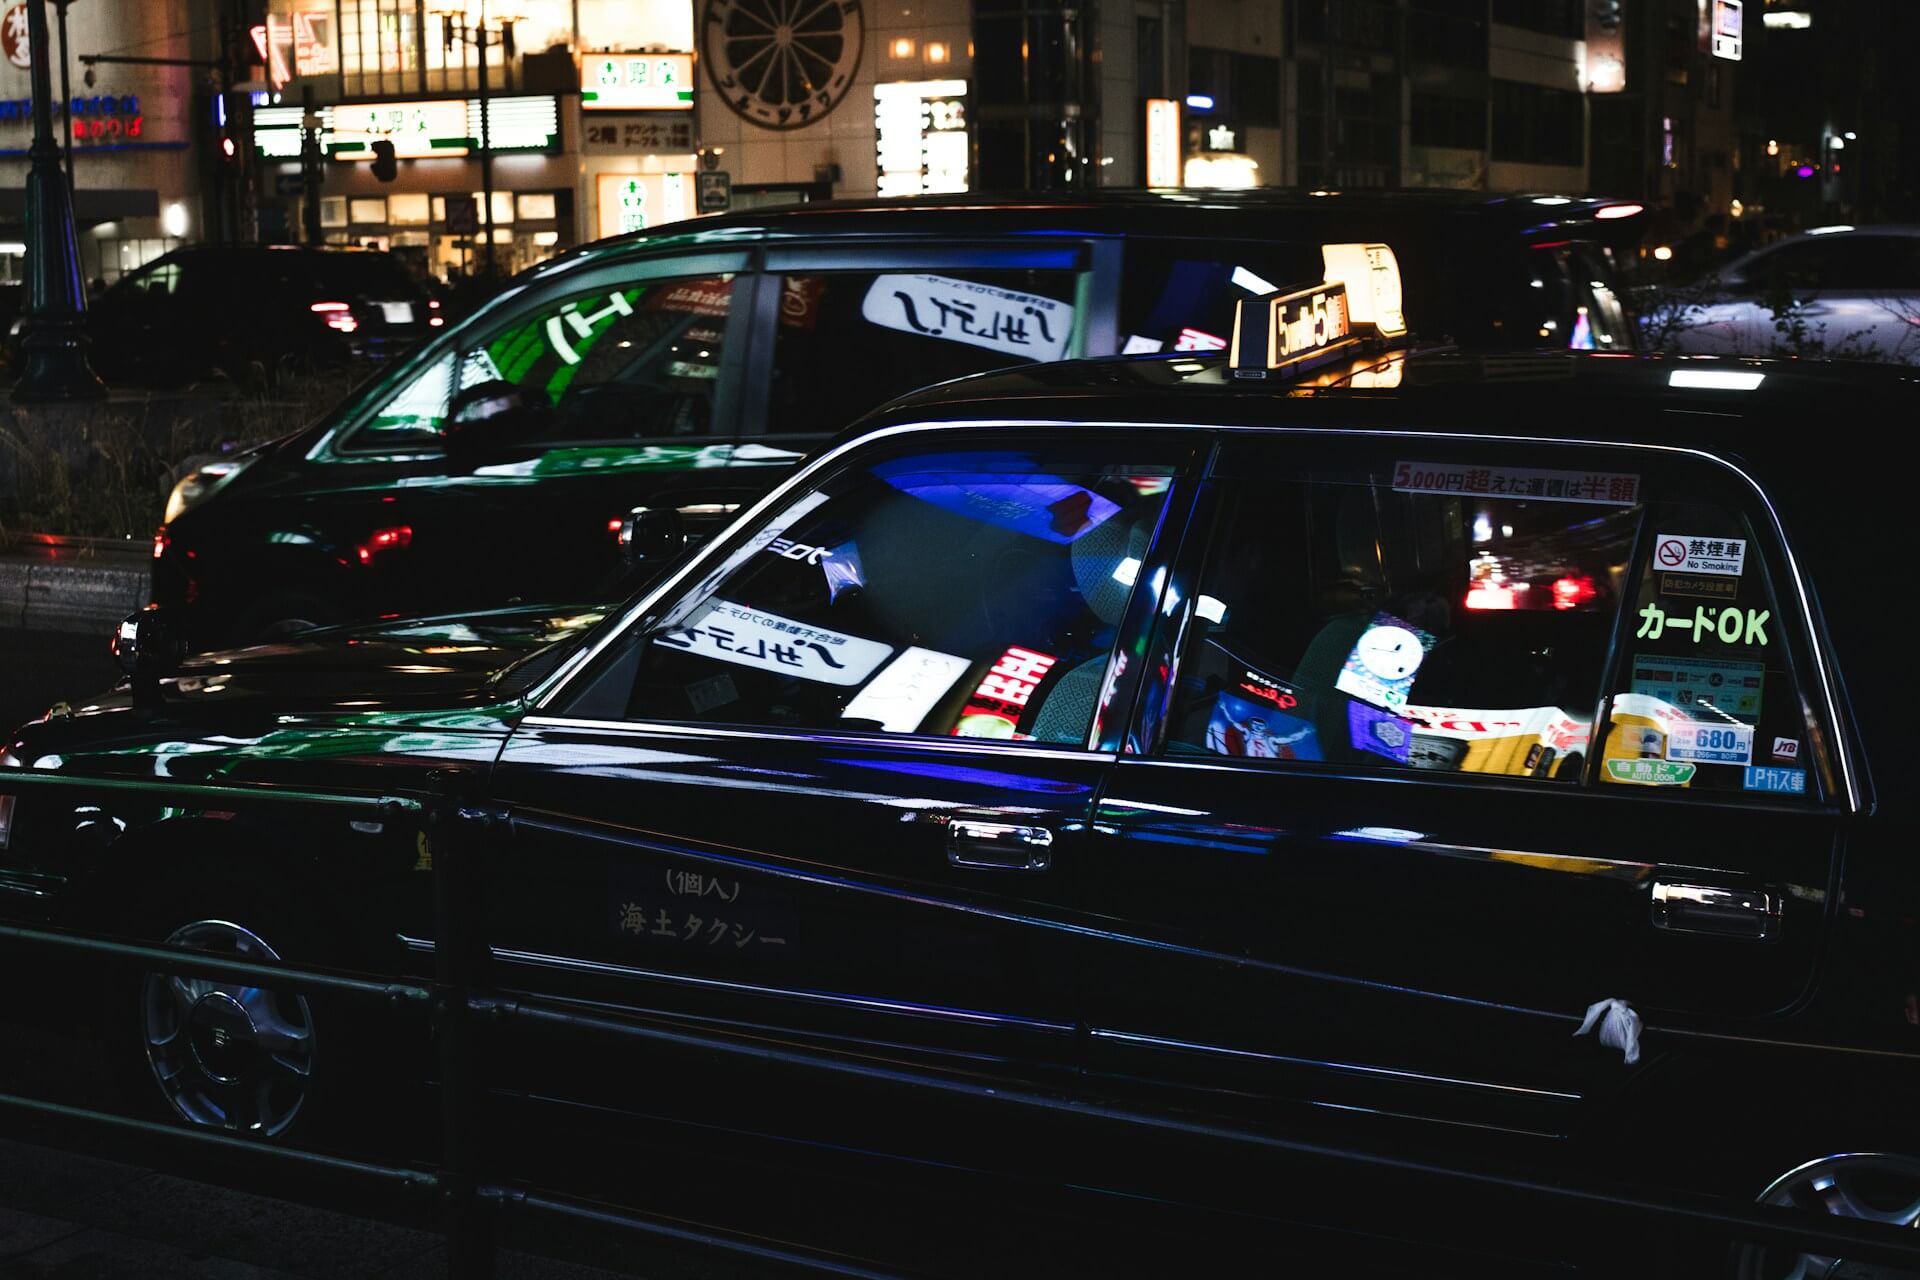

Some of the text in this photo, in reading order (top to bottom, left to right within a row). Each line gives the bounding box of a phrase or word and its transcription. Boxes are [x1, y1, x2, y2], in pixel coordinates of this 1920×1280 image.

[1689, 539, 1742, 558] 禁煙車
[1687, 560, 1739, 573] No Smoking
[1636, 602, 1770, 646] カードOK
[1774, 740, 1797, 753] JTB
[1616, 760, 1690, 775] 自動ドア
[1631, 772, 1676, 782] AUTO DOOR
[1745, 767, 1806, 792] LPガス車
[665, 868, 740, 903] (個人)
